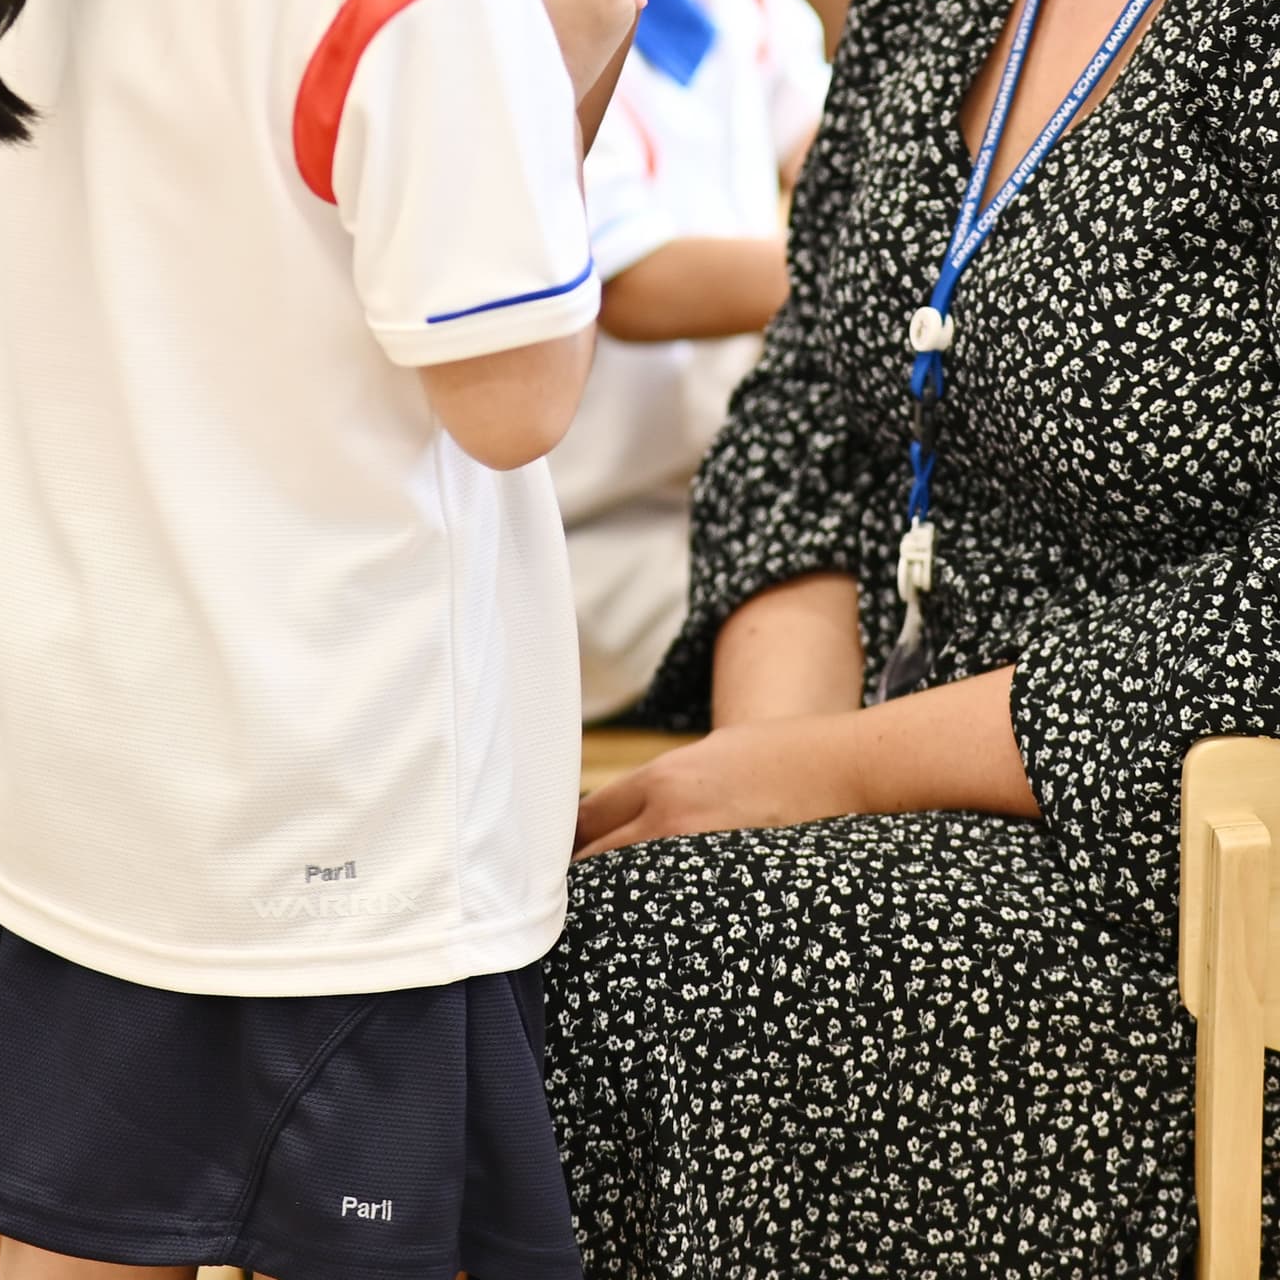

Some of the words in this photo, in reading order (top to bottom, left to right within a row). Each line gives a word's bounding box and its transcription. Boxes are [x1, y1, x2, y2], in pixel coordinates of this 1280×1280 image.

[967, 149, 992, 200] SCHOOL
[977, 181, 1016, 232] COLLEGE
[1012, 98, 1078, 185] INTERNATIONAL
[1073, 51, 1109, 99] SCHOOL
